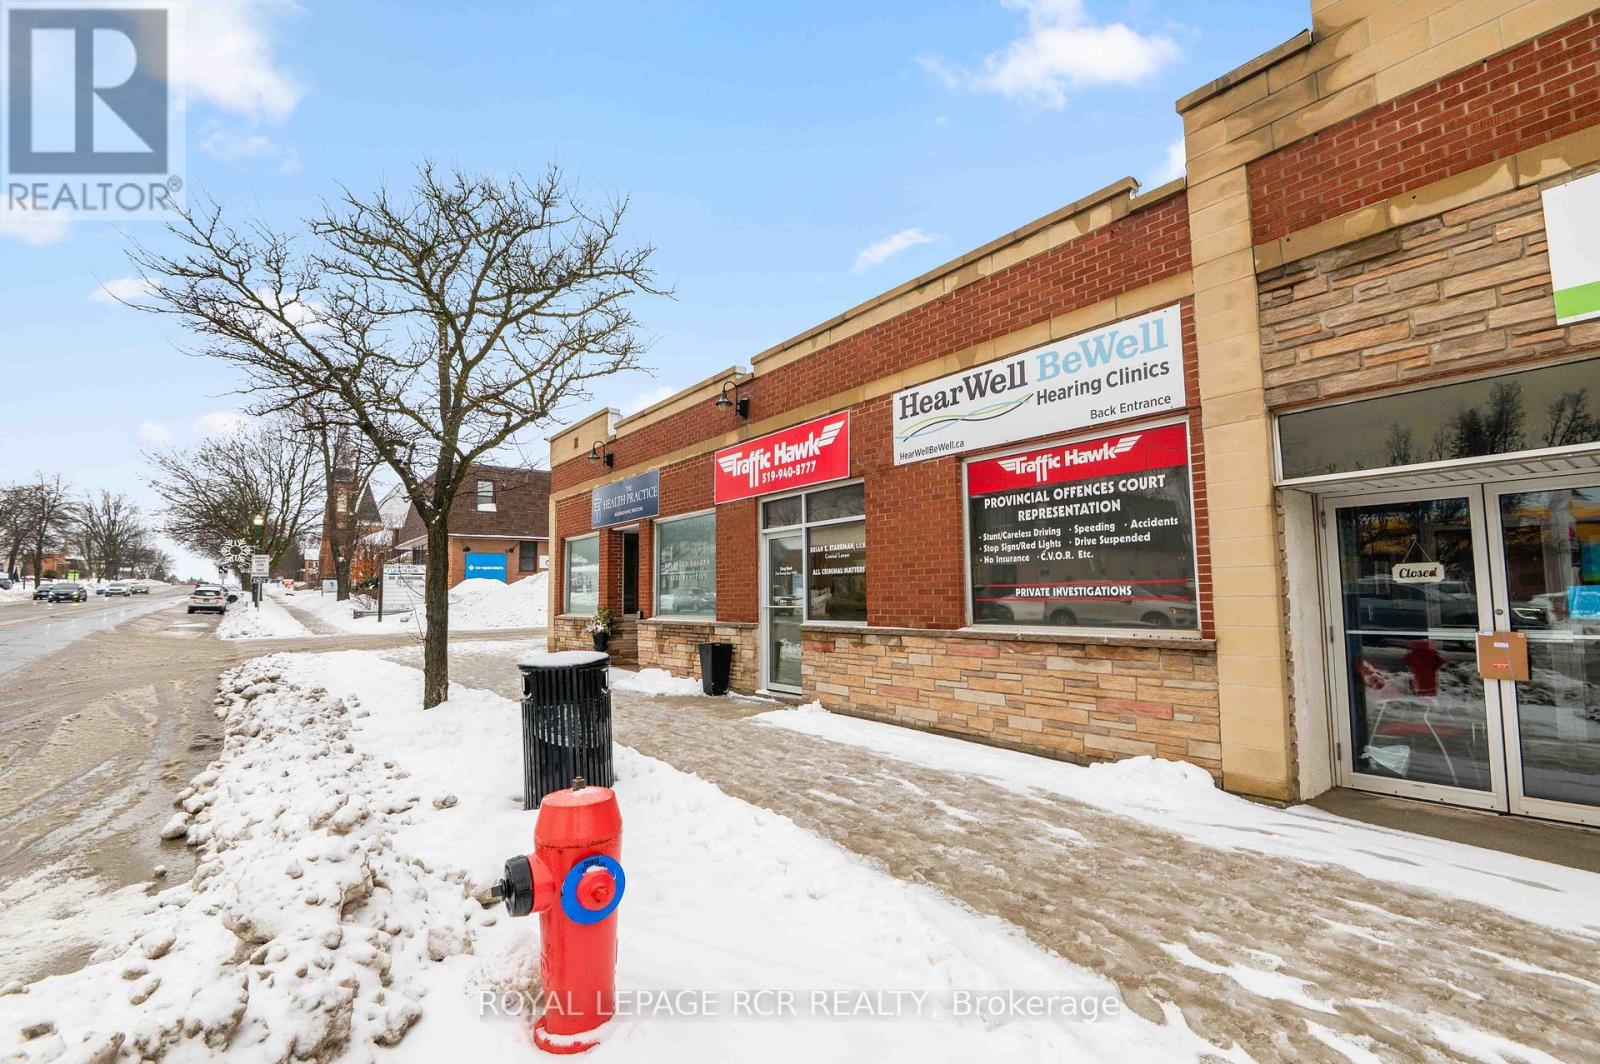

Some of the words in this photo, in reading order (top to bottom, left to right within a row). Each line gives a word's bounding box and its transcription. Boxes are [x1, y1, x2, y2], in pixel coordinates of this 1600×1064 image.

[899, 360, 1028, 420] HearWell
[1035, 317, 1169, 383] BeWell
[1036, 376, 1102, 406] Hearing
[1106, 361, 1170, 389] Clinics
[1090, 407, 1117, 420] Back
[1120, 395, 1171, 414] Entrance
[899, 439, 965, 461] HearWellBeWell.ca
[717, 447, 771, 488] Traffic
[774, 431, 825, 466] Hawk
[997, 453, 1061, 482] Traffic
[1065, 440, 1121, 467] Hawk
[761, 460, 817, 484] 519-940-8777
[603, 494, 626, 510] HEALTH
[626, 485, 658, 504] PRACTICE
[984, 490, 1050, 510] PROVINCIAL
[1053, 482, 1115, 500] OFFENCES
[1118, 474, 1166, 492] COURT
[1018, 499, 1121, 522] REPRESENTATION
[1074, 522, 1115, 534] Speeding
[1130, 516, 1179, 529] Accidents
[983, 530, 1032, 541] Stunt/Careless
[1033, 527, 1061, 538] Driving
[1074, 536, 1097, 547] Drive
[1099, 532, 1151, 545] Suspended
[983, 544, 1000, 554] Stop
[1001, 541, 1036, 552] Signs/Red
[1038, 539, 1062, 550] Lights
[984, 556, 994, 564] No
[996, 554, 1030, 563] Insurance
[1040, 551, 1074, 561] C.V.O.R.
[1078, 551, 1094, 560] Etc.
[821, 567, 843, 575] CRIMINAL
[843, 566, 866, 574] MATTERS
[1399, 567, 1438, 579] Closed
[1015, 587, 1051, 597] PRIVATE
[1053, 585, 1132, 597] INVESTIGATIONS
